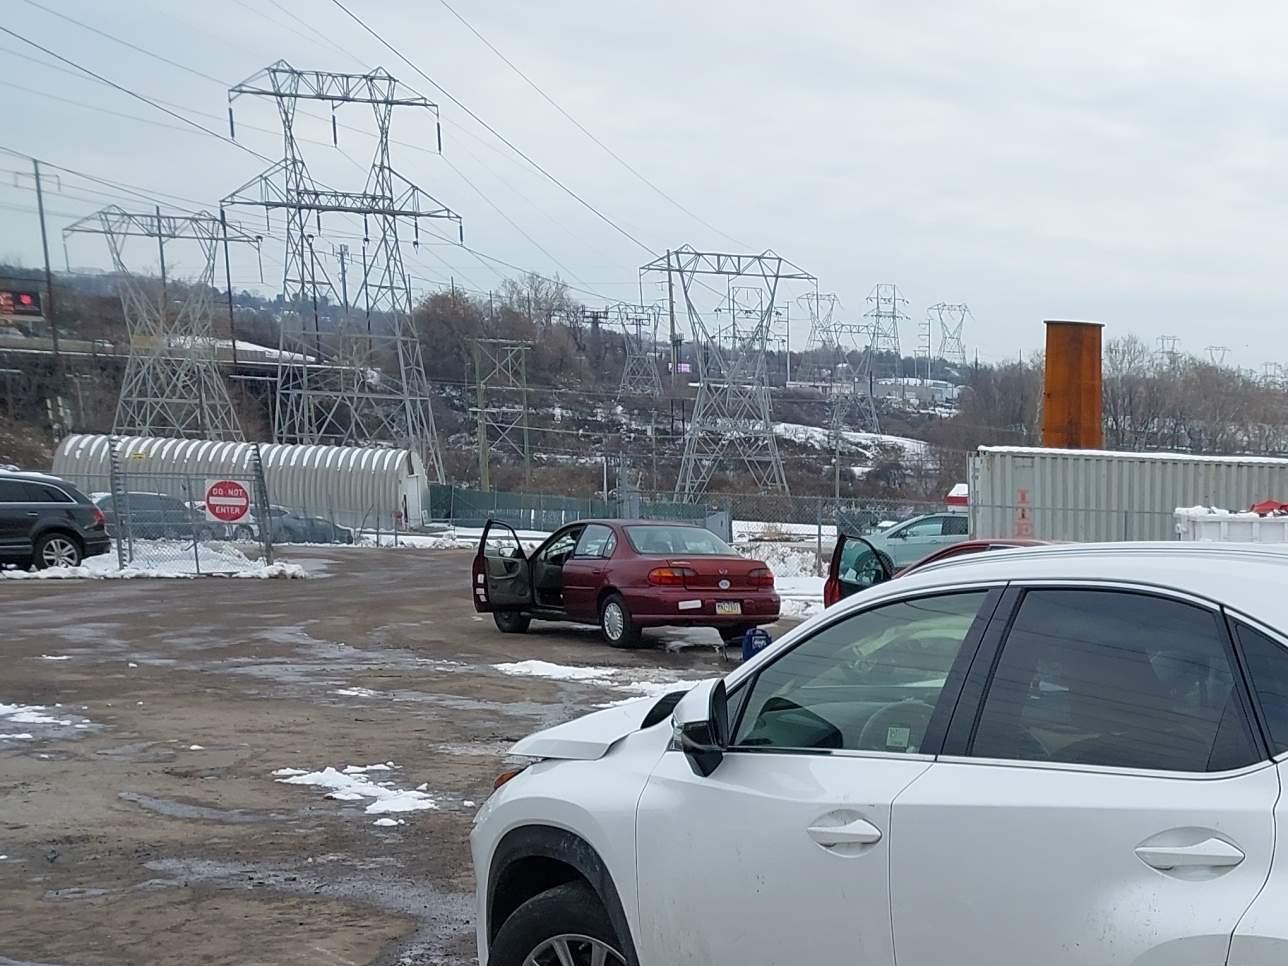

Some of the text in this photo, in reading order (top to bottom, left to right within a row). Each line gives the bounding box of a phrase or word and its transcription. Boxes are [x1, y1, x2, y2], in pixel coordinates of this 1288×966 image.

[212, 487, 243, 496] DO NOT
[215, 506, 240, 514] ENTER
